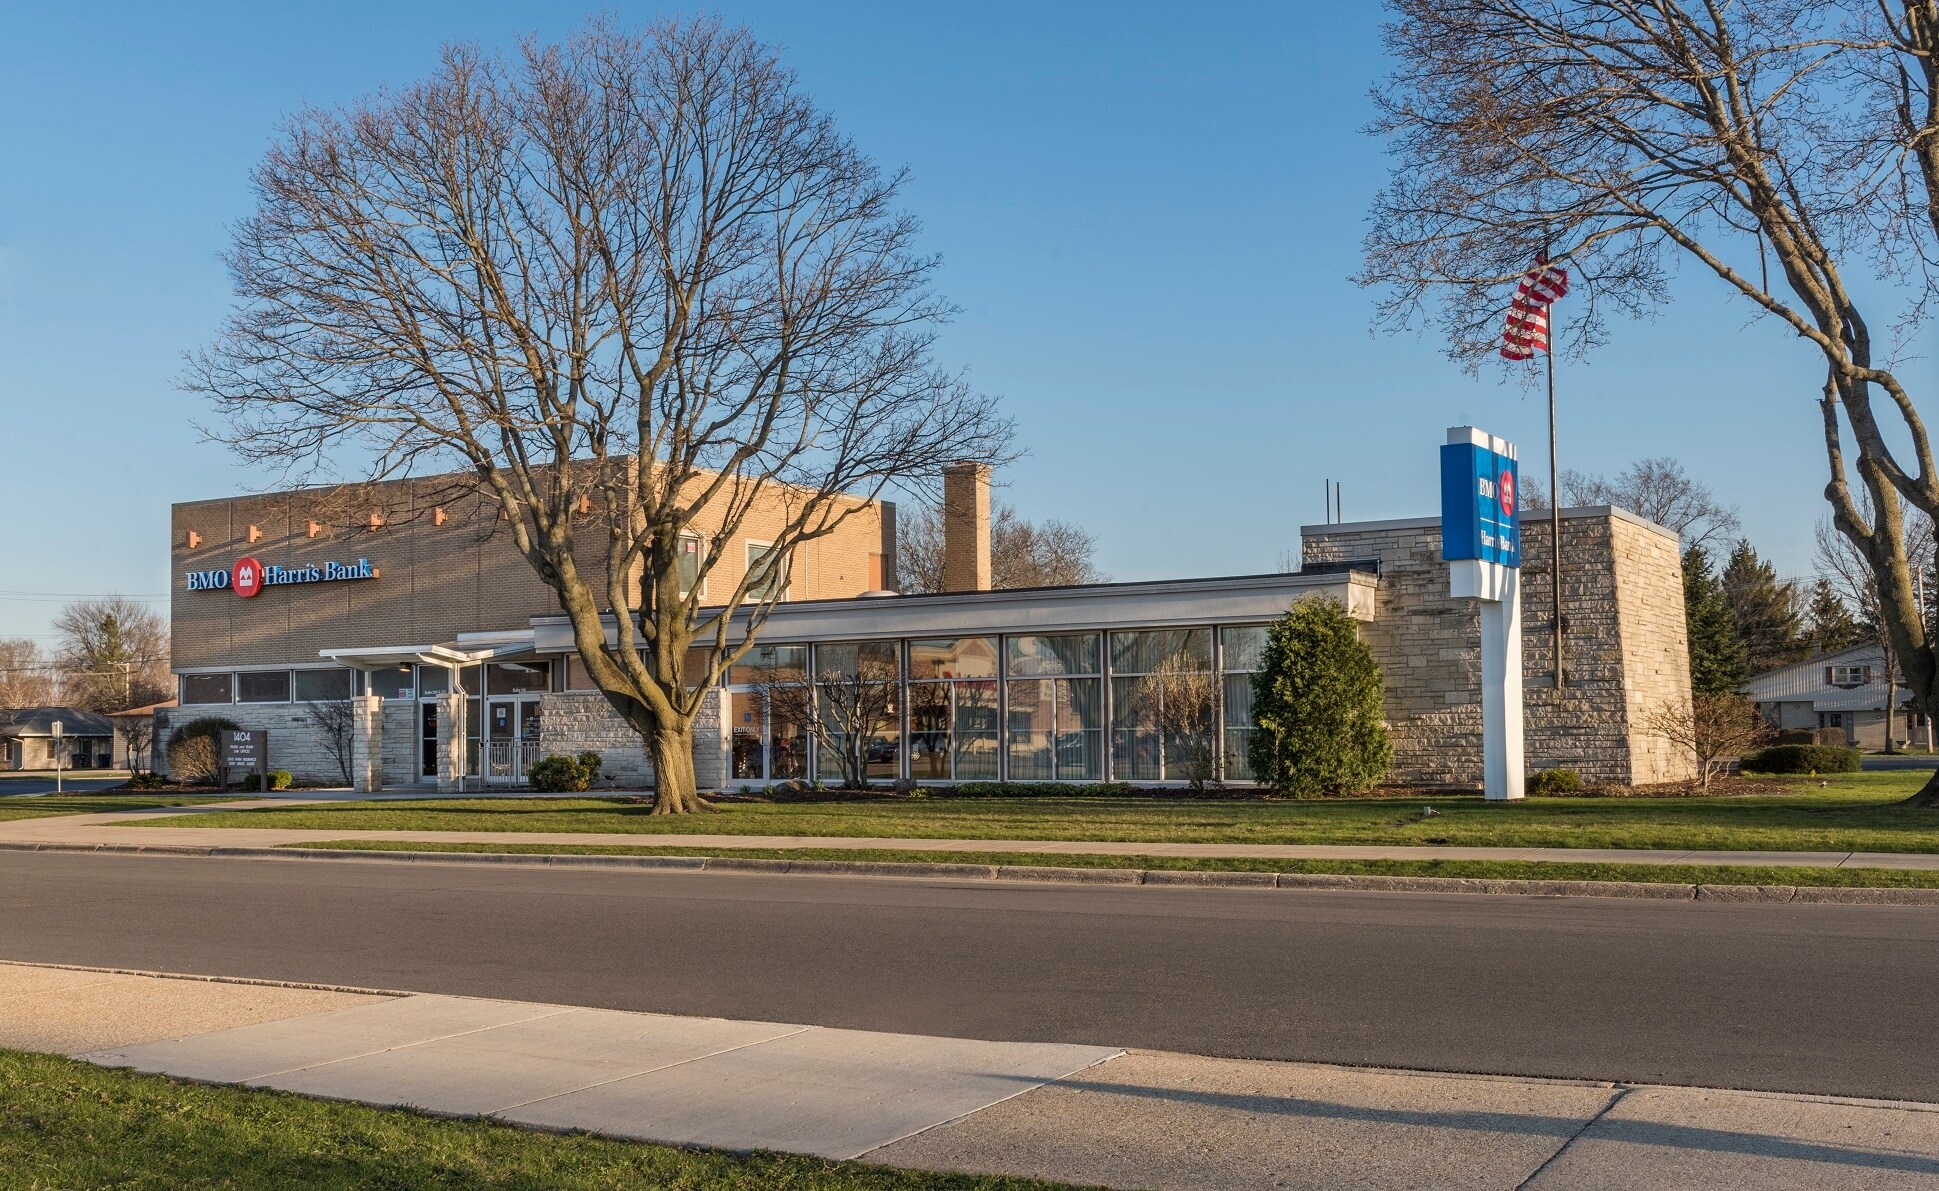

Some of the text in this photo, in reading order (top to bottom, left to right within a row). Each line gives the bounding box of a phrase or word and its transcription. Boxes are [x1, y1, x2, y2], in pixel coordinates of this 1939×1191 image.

[1479, 477, 1498, 499] BMO
[1480, 530, 1515, 552] Harris Bank
[187, 558, 373, 590] BMO Harris Bank
[234, 732, 250, 741] 1404
